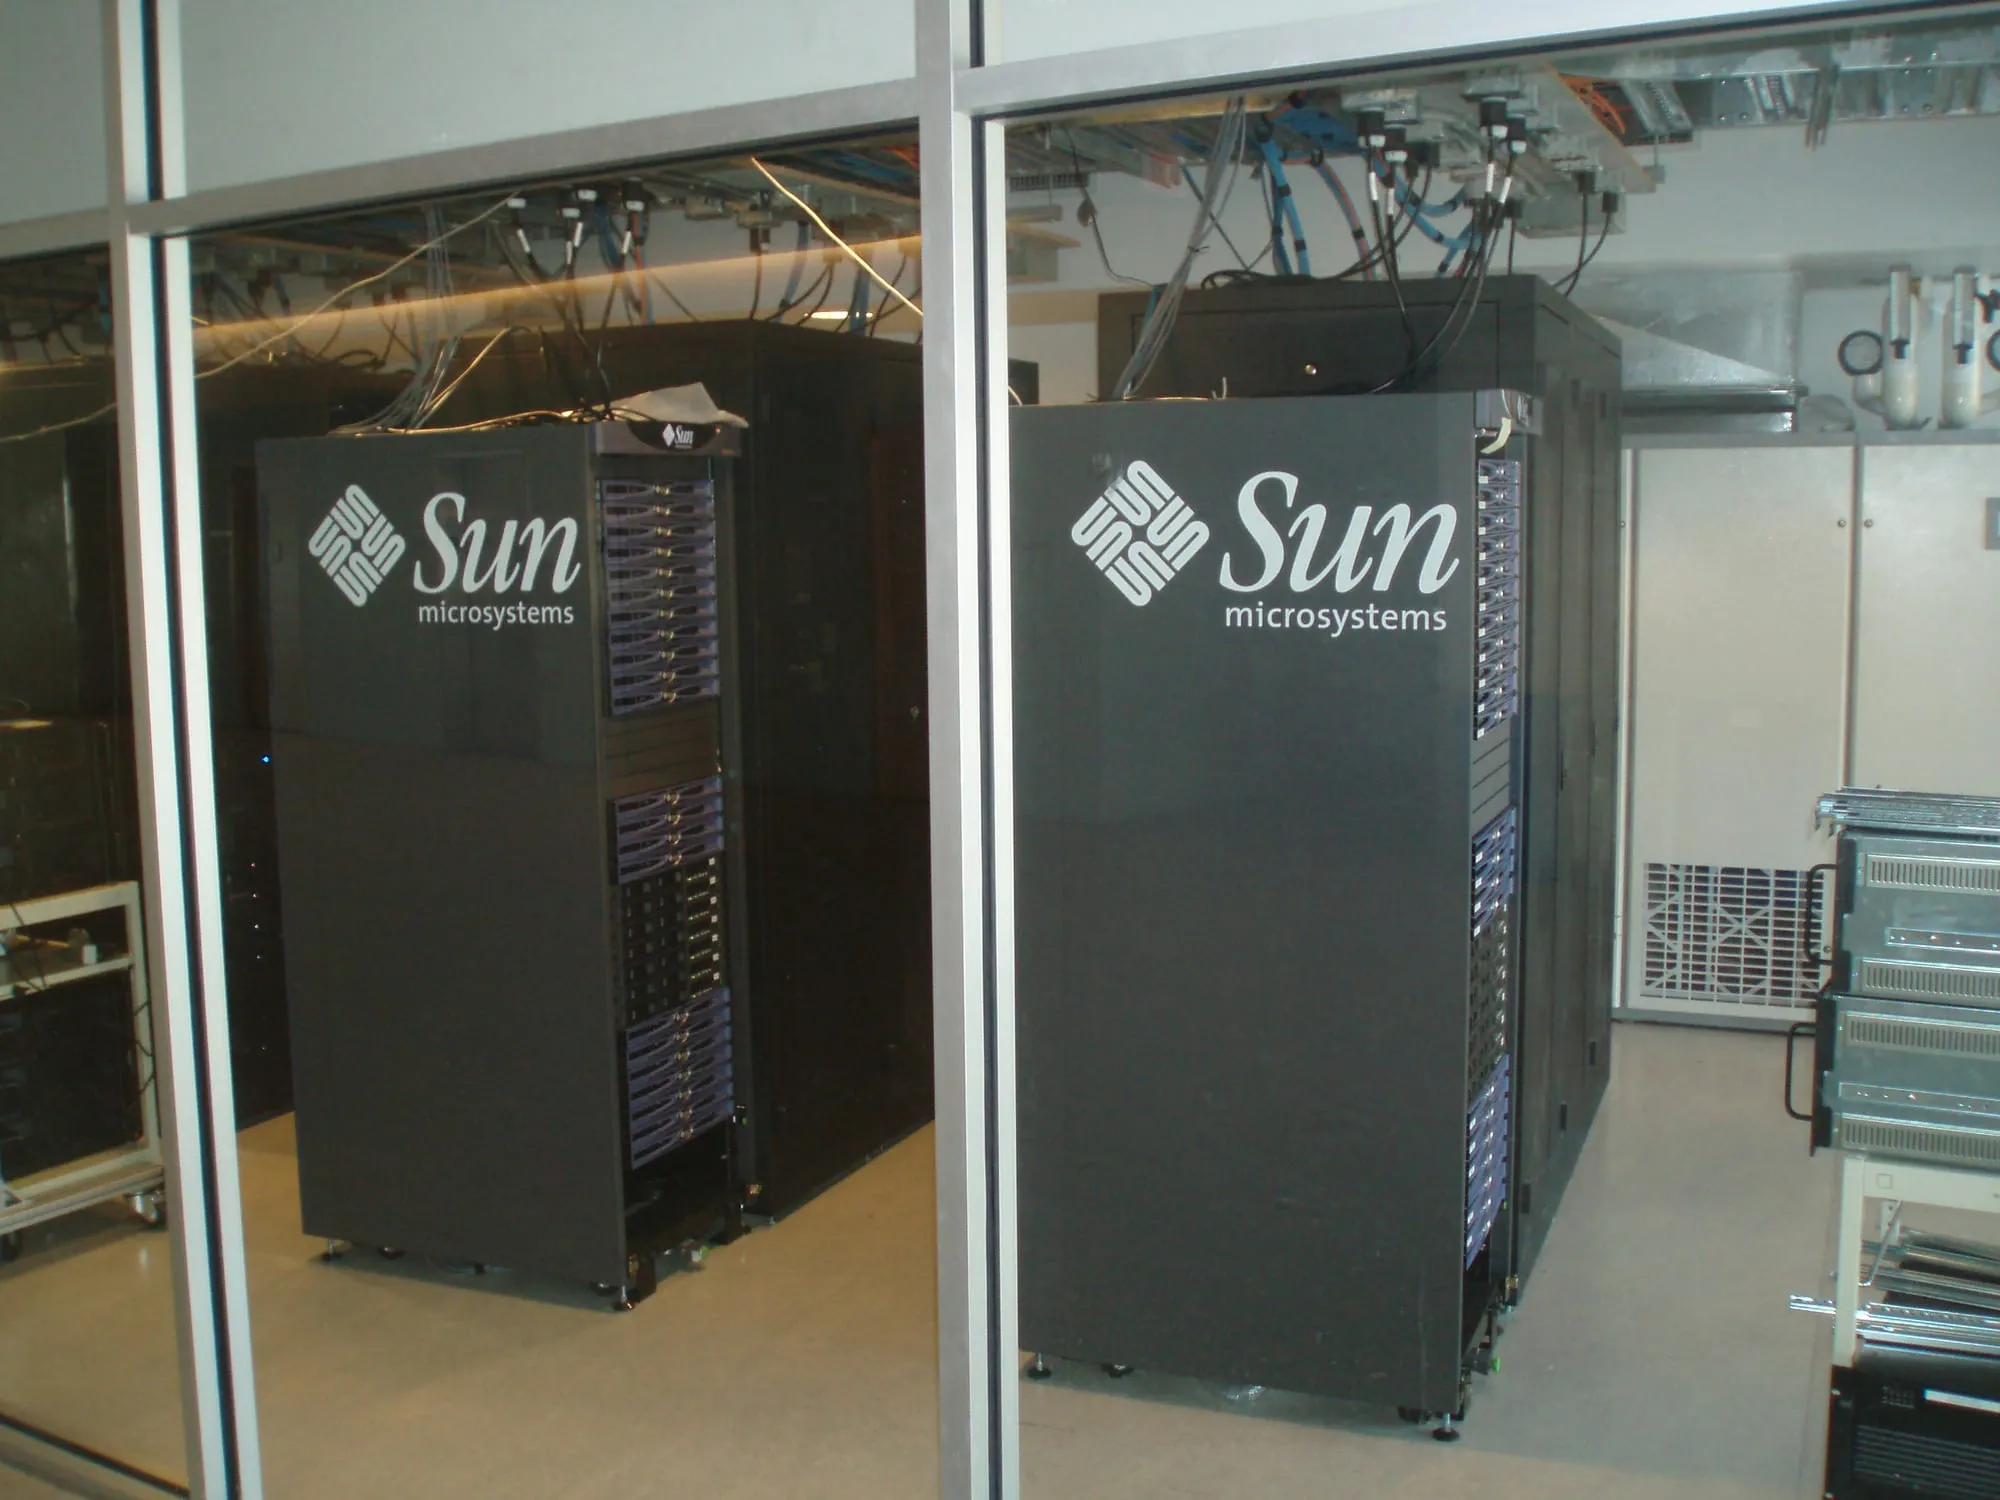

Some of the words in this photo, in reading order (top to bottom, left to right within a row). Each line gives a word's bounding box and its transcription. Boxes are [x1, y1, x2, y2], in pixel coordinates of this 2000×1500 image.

[675, 424, 694, 444] Sun
[412, 491, 582, 595] Sun
[1219, 471, 1461, 595] Sun
[418, 600, 575, 631] microsystems
[1225, 601, 1448, 638] microsystems
